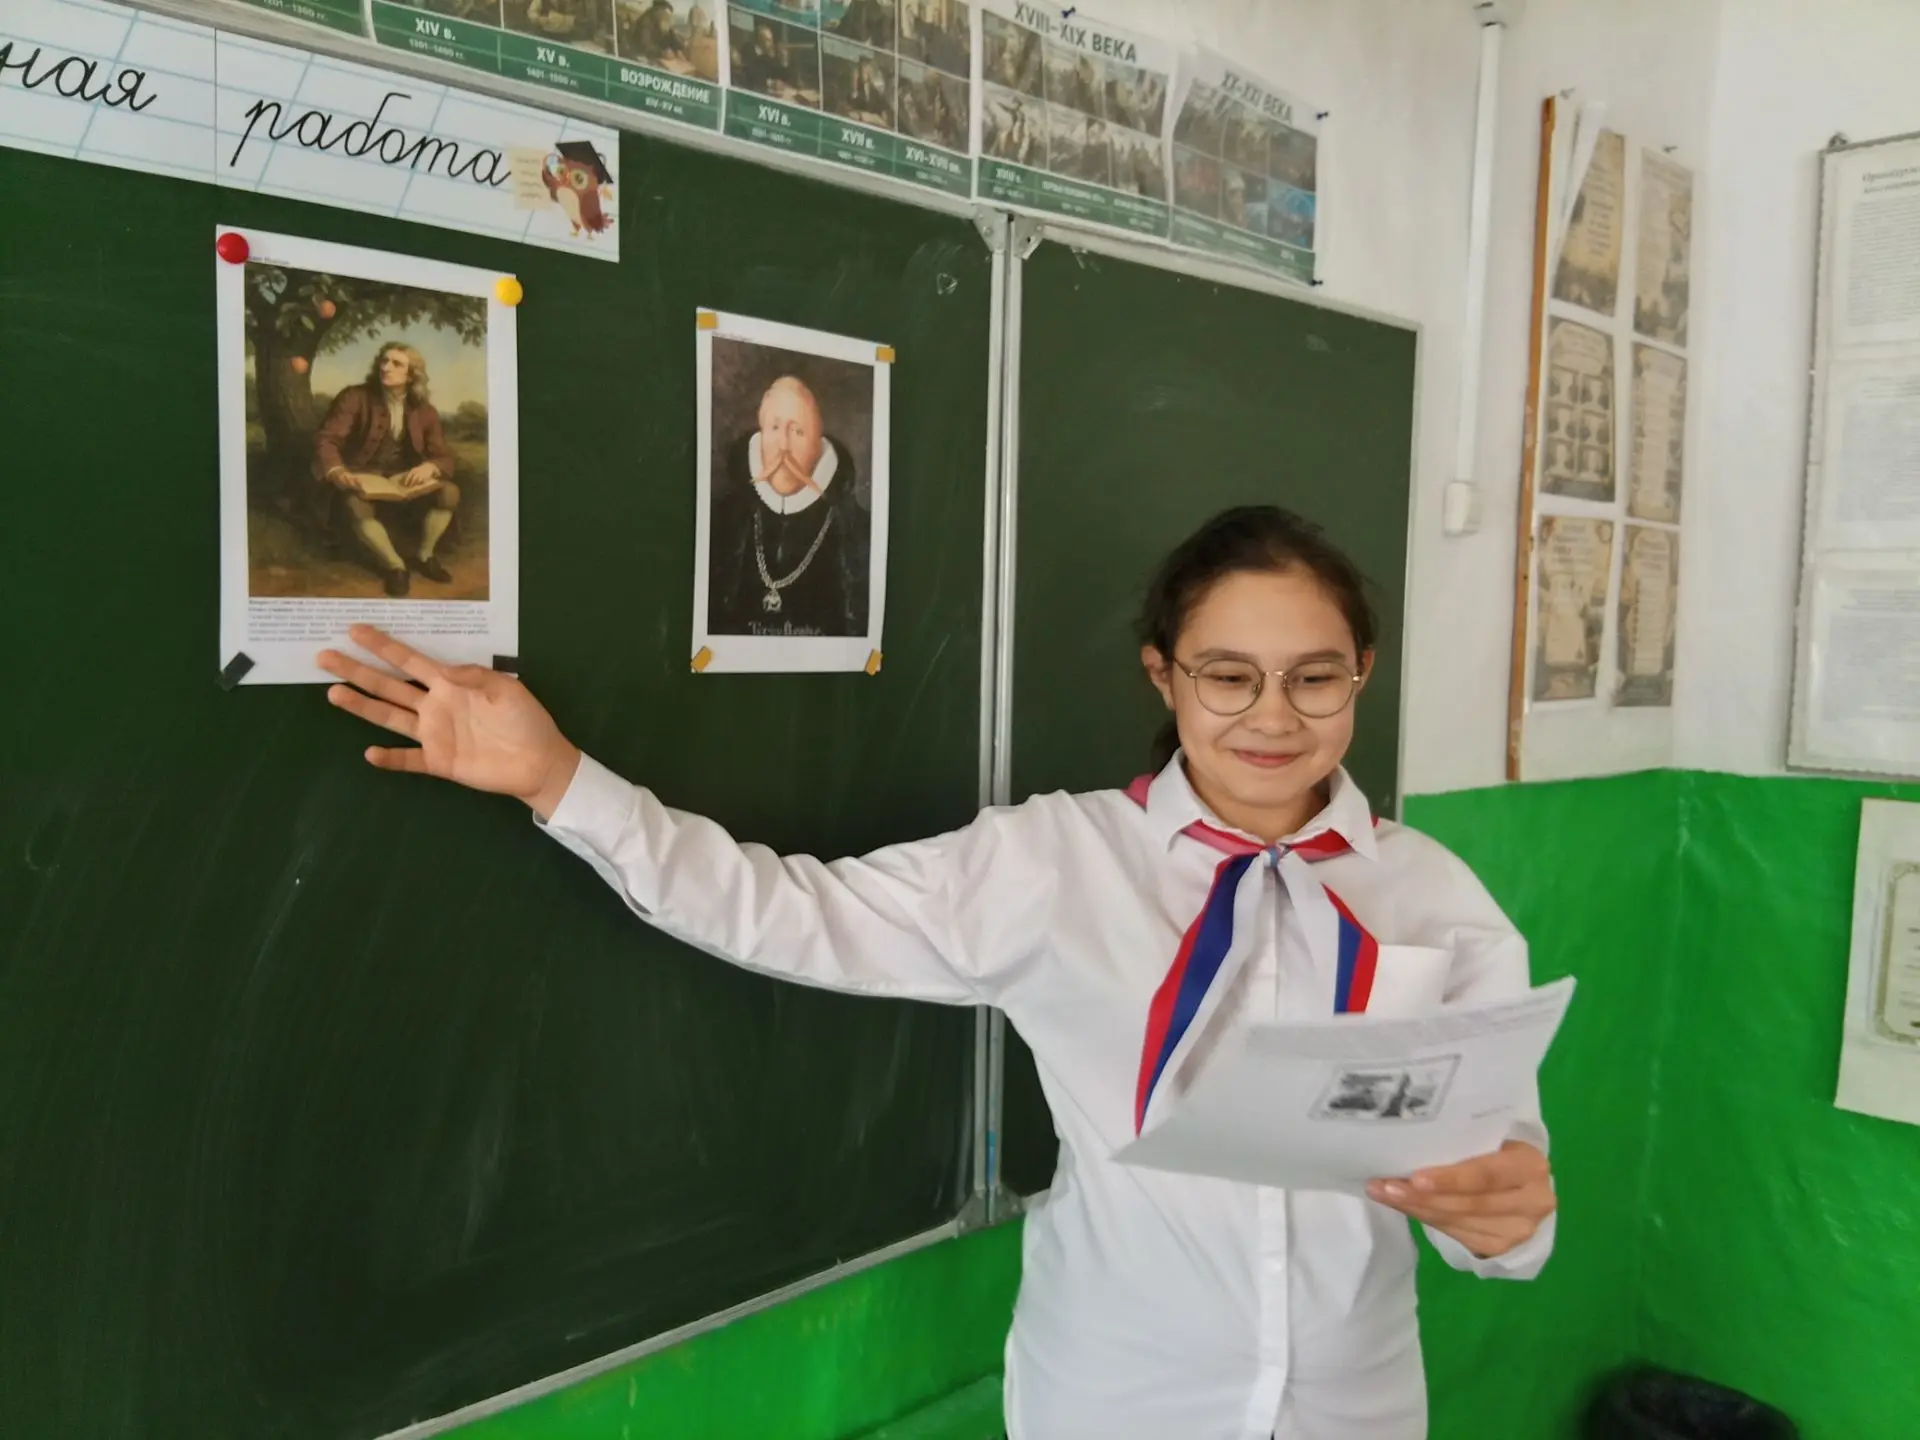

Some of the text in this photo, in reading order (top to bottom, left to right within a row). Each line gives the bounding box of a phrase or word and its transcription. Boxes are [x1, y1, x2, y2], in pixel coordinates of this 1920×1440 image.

[415, 17, 440, 36] XIV
[537, 46, 556, 64] XV
[1092, 32, 1136, 62] ВЕКА
[620, 67, 710, 104] ВОЗРОЖДЕНИЕ
[758, 104, 780, 123] XVI
[230, 92, 512, 187] работа
[841, 128, 865, 147] XVII
